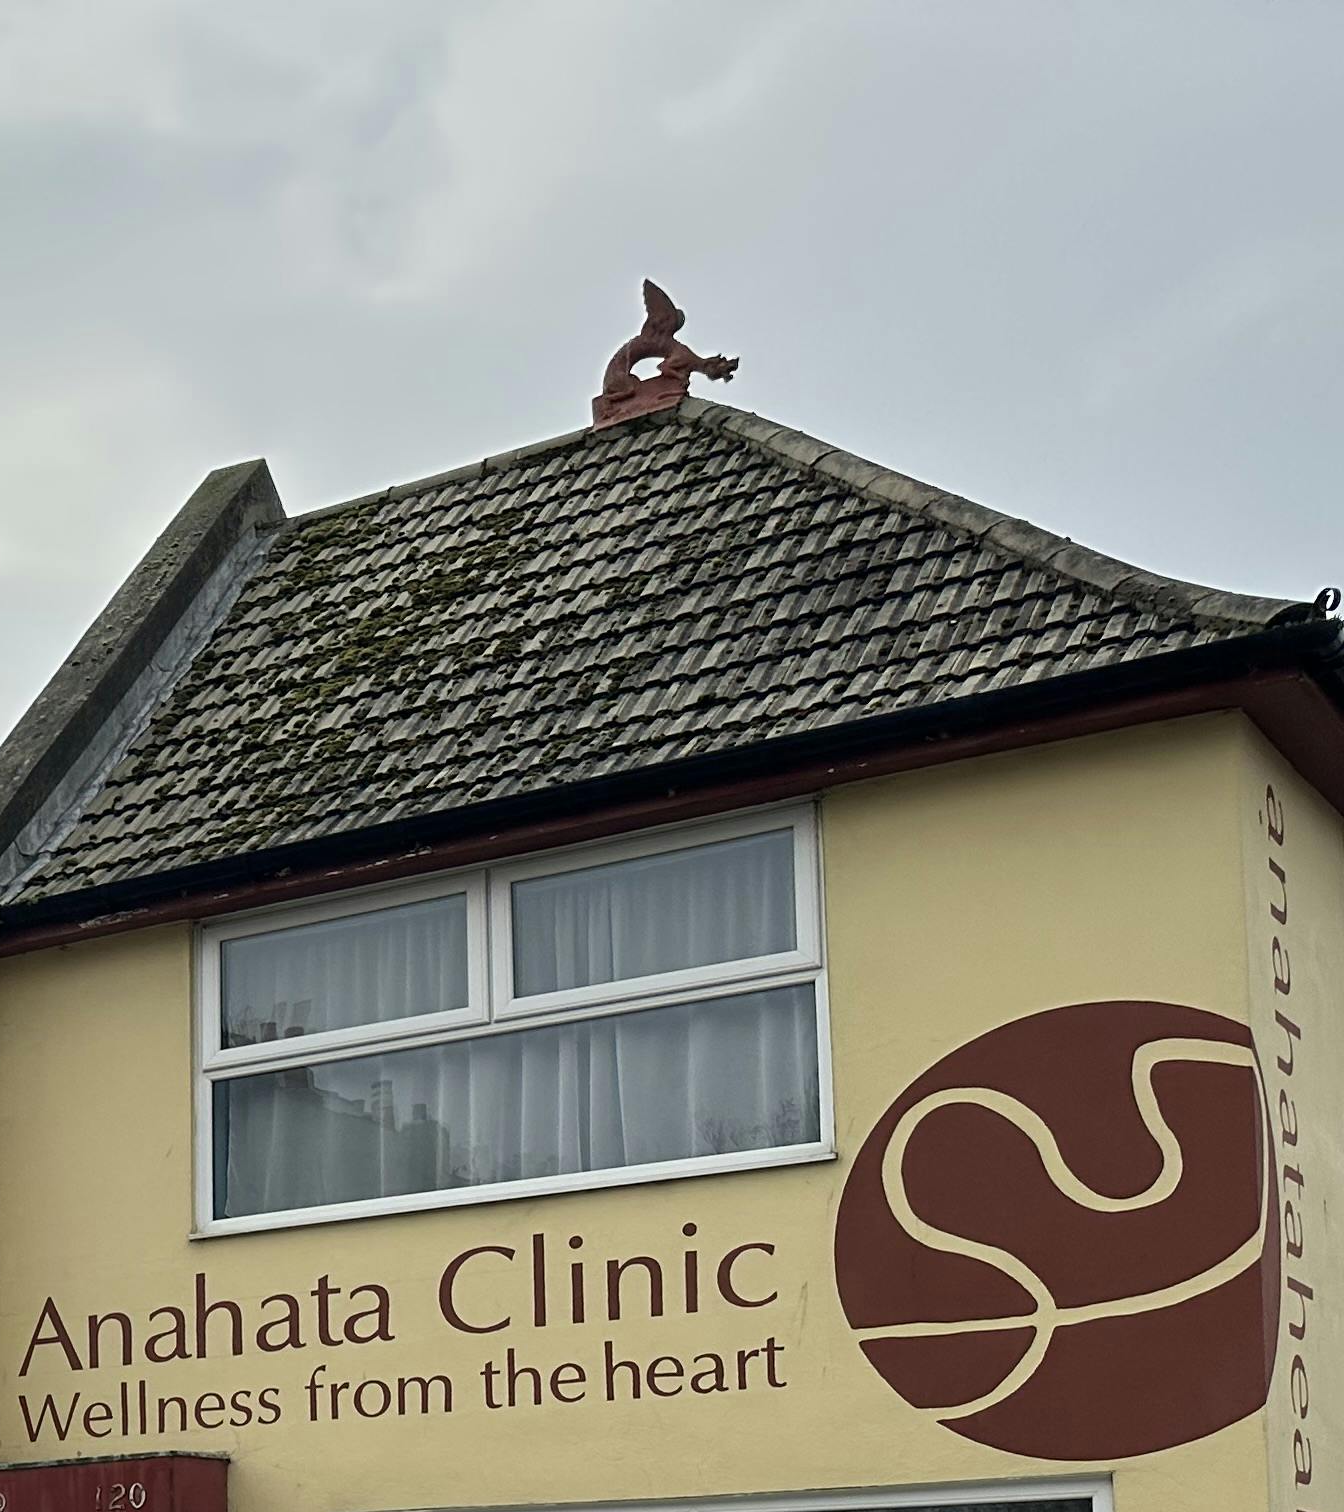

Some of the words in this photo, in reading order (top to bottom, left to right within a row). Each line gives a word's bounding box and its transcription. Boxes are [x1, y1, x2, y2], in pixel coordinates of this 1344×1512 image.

[19, 1272, 395, 1378] Anahata
[439, 1222, 779, 1335] Clinic
[19, 1379, 281, 1444] Wellness
[305, 1364, 453, 1423] from
[481, 1347, 586, 1409] the
[605, 1336, 788, 1402] heart
[95, 1482, 146, 1511] 120
